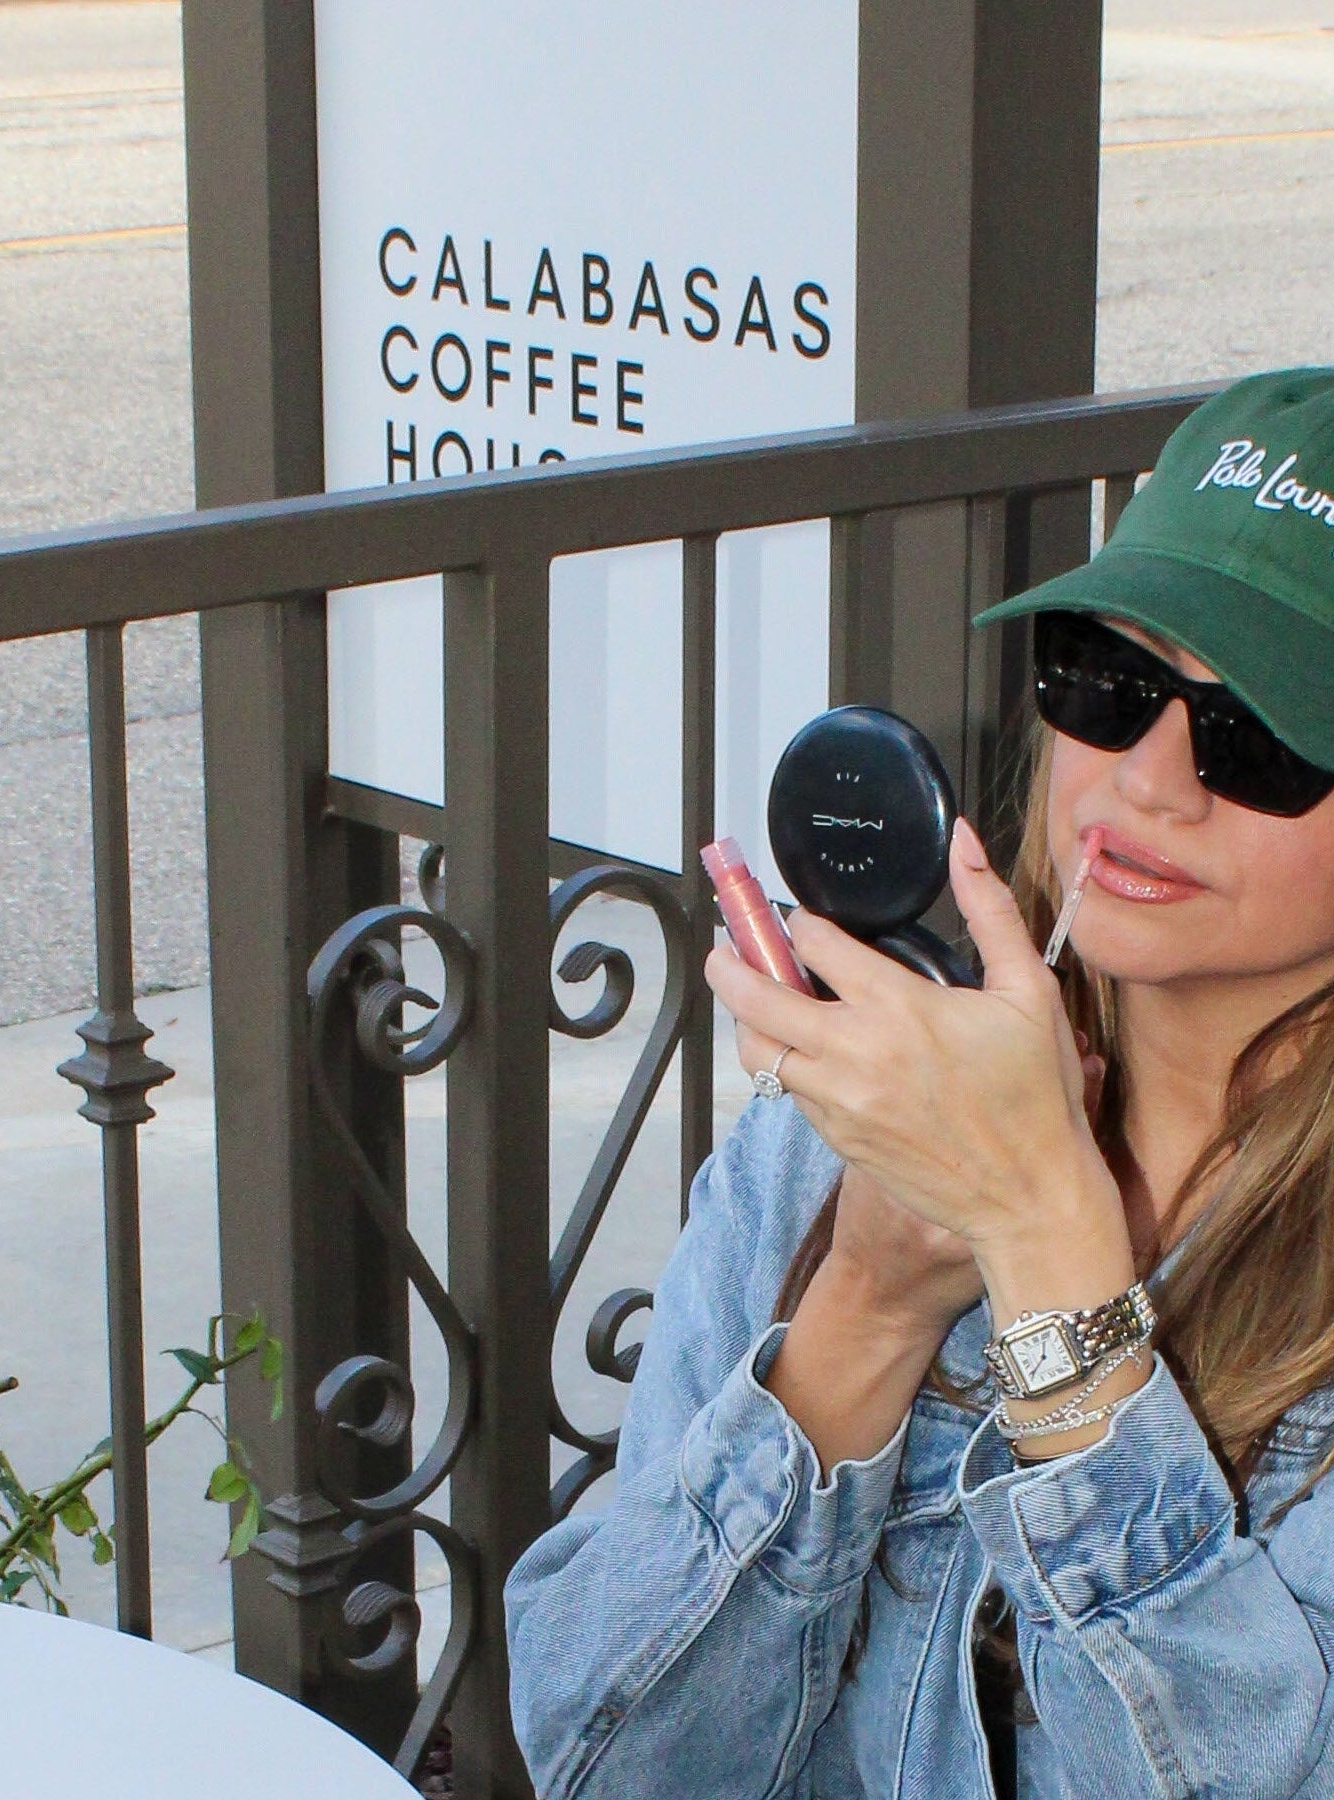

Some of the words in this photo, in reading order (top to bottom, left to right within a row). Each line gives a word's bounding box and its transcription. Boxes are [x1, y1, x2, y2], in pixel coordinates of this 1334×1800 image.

[378, 227, 830, 360] CALABASAS
[380, 324, 645, 434] COFFEE
[1194, 439, 1267, 491] Polo
[813, 814, 883, 831] MAC
